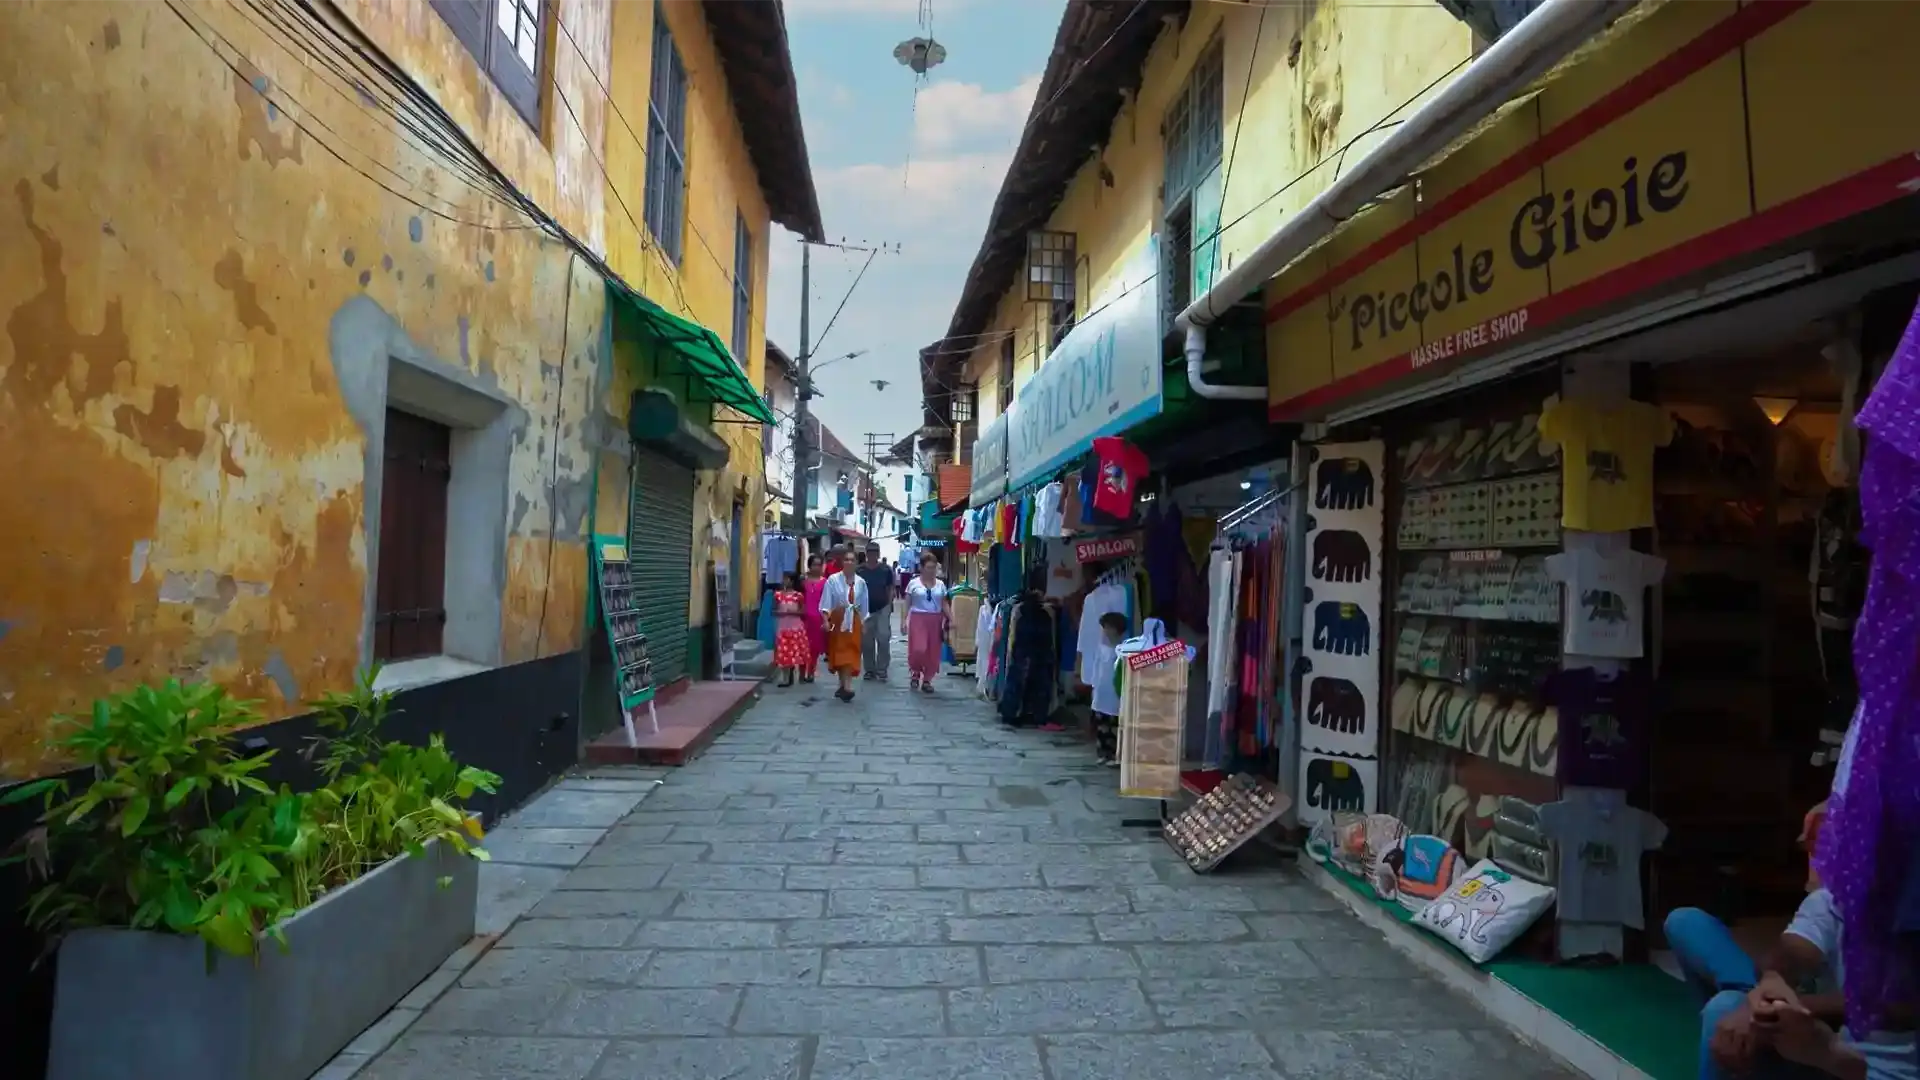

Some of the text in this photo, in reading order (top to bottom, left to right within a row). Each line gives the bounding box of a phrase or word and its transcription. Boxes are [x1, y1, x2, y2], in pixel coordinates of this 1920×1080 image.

[1350, 241, 1494, 351] Piccole
[1510, 151, 1689, 269] Gioie
[1410, 307, 1528, 369] HASSLE FREE SHOP
[1019, 322, 1116, 461] SHALOM
[1077, 539, 1136, 559] SHALOM
